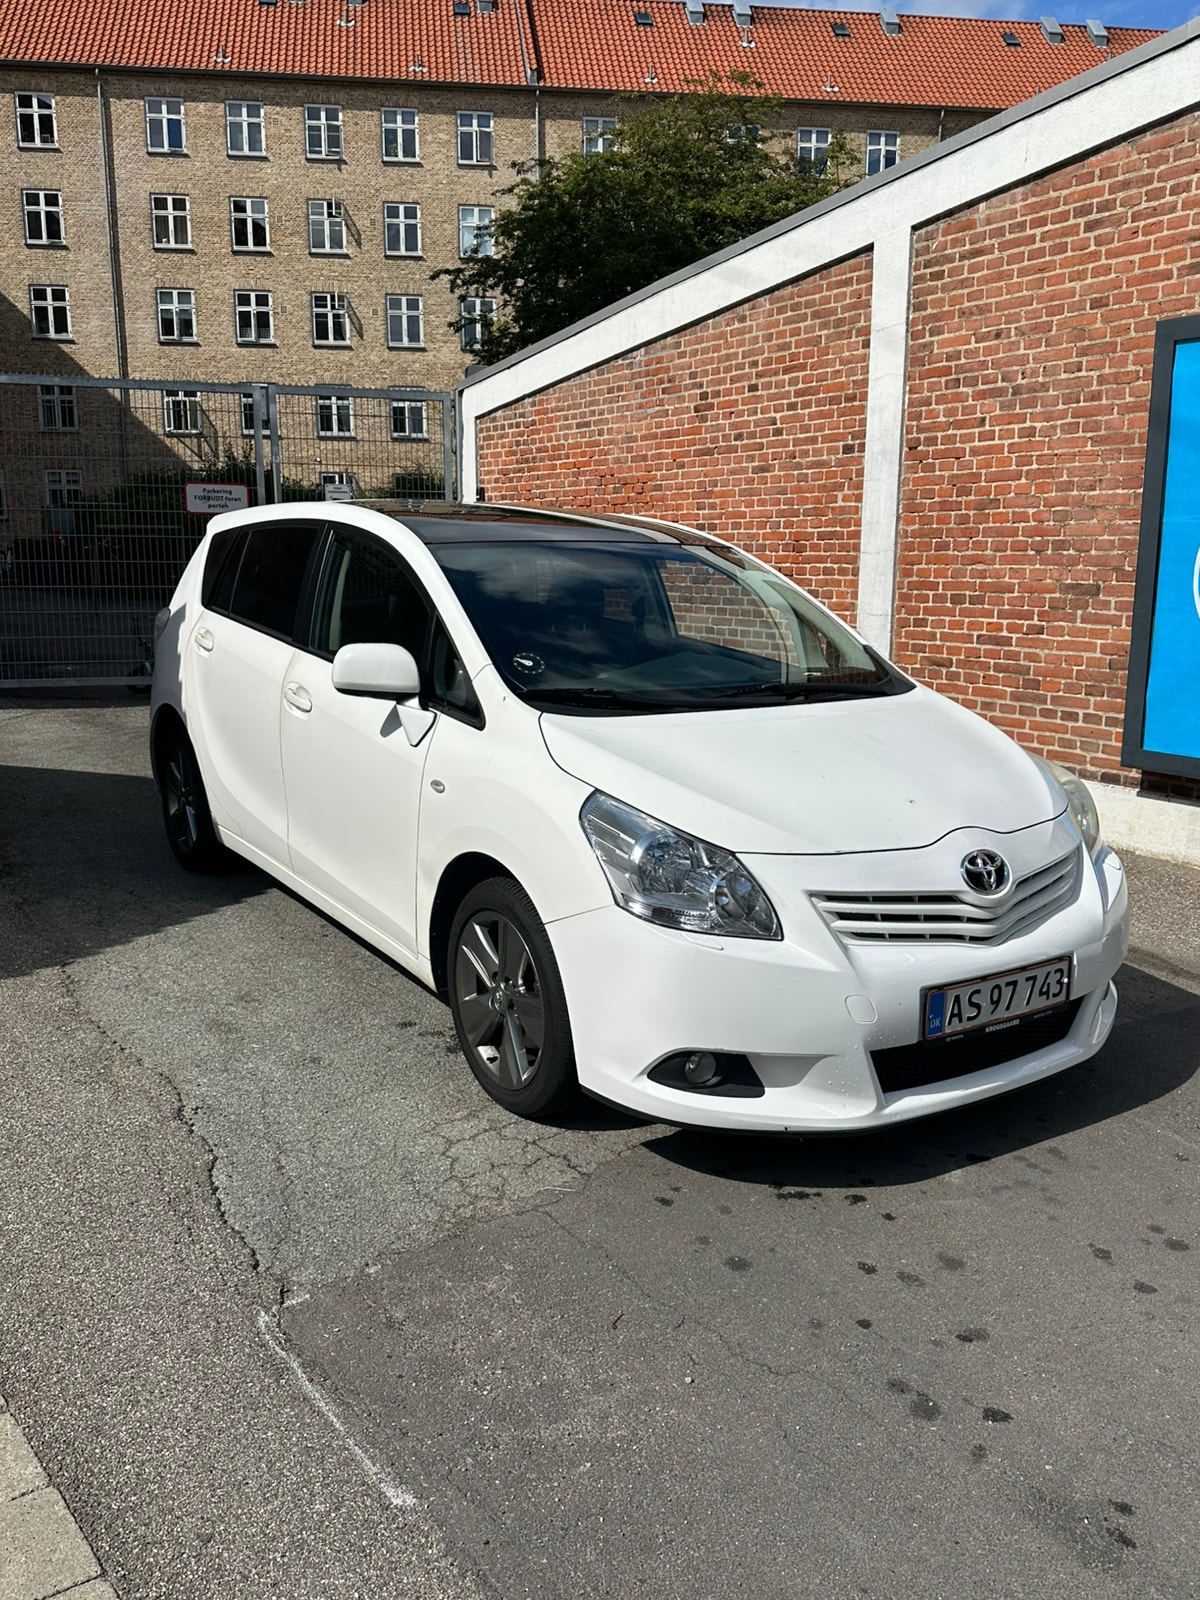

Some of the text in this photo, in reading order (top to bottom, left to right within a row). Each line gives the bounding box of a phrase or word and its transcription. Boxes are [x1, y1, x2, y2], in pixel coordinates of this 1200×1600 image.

[946, 967, 1065, 1026] AS 97 743
[930, 1017, 941, 1029] DK
